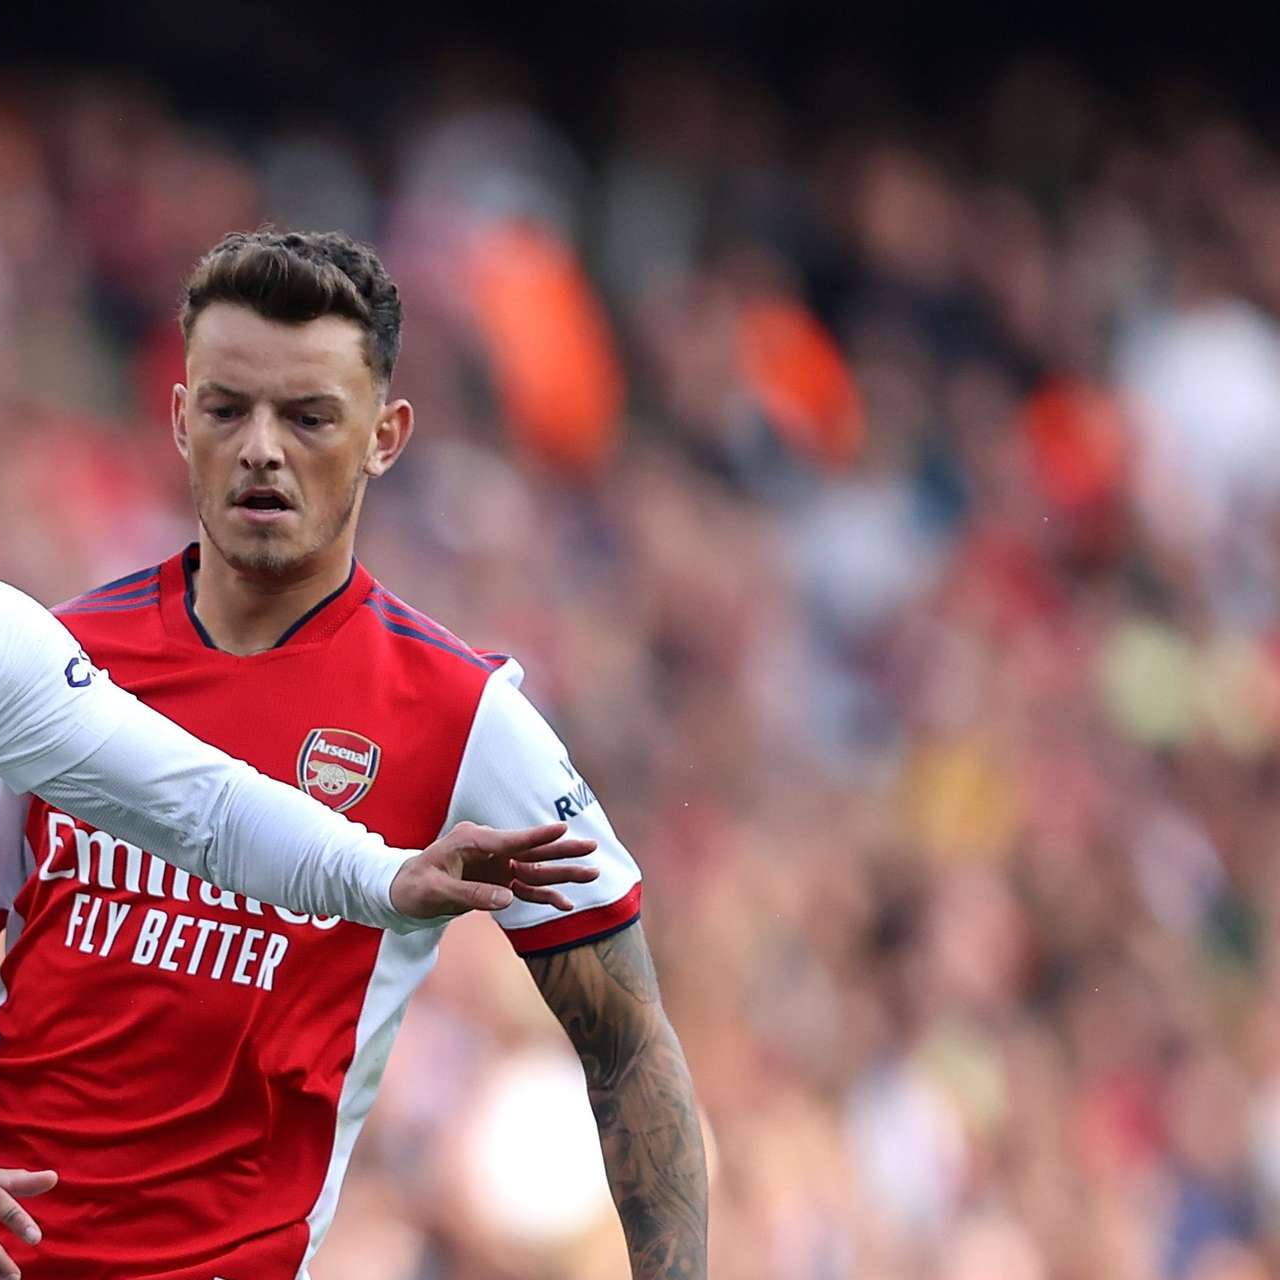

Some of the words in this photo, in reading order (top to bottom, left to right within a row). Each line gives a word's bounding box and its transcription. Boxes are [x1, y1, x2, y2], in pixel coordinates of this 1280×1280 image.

[313, 739, 370, 767] Arsenal
[64, 893, 132, 958] FLY
[131, 908, 289, 992] BETTER
